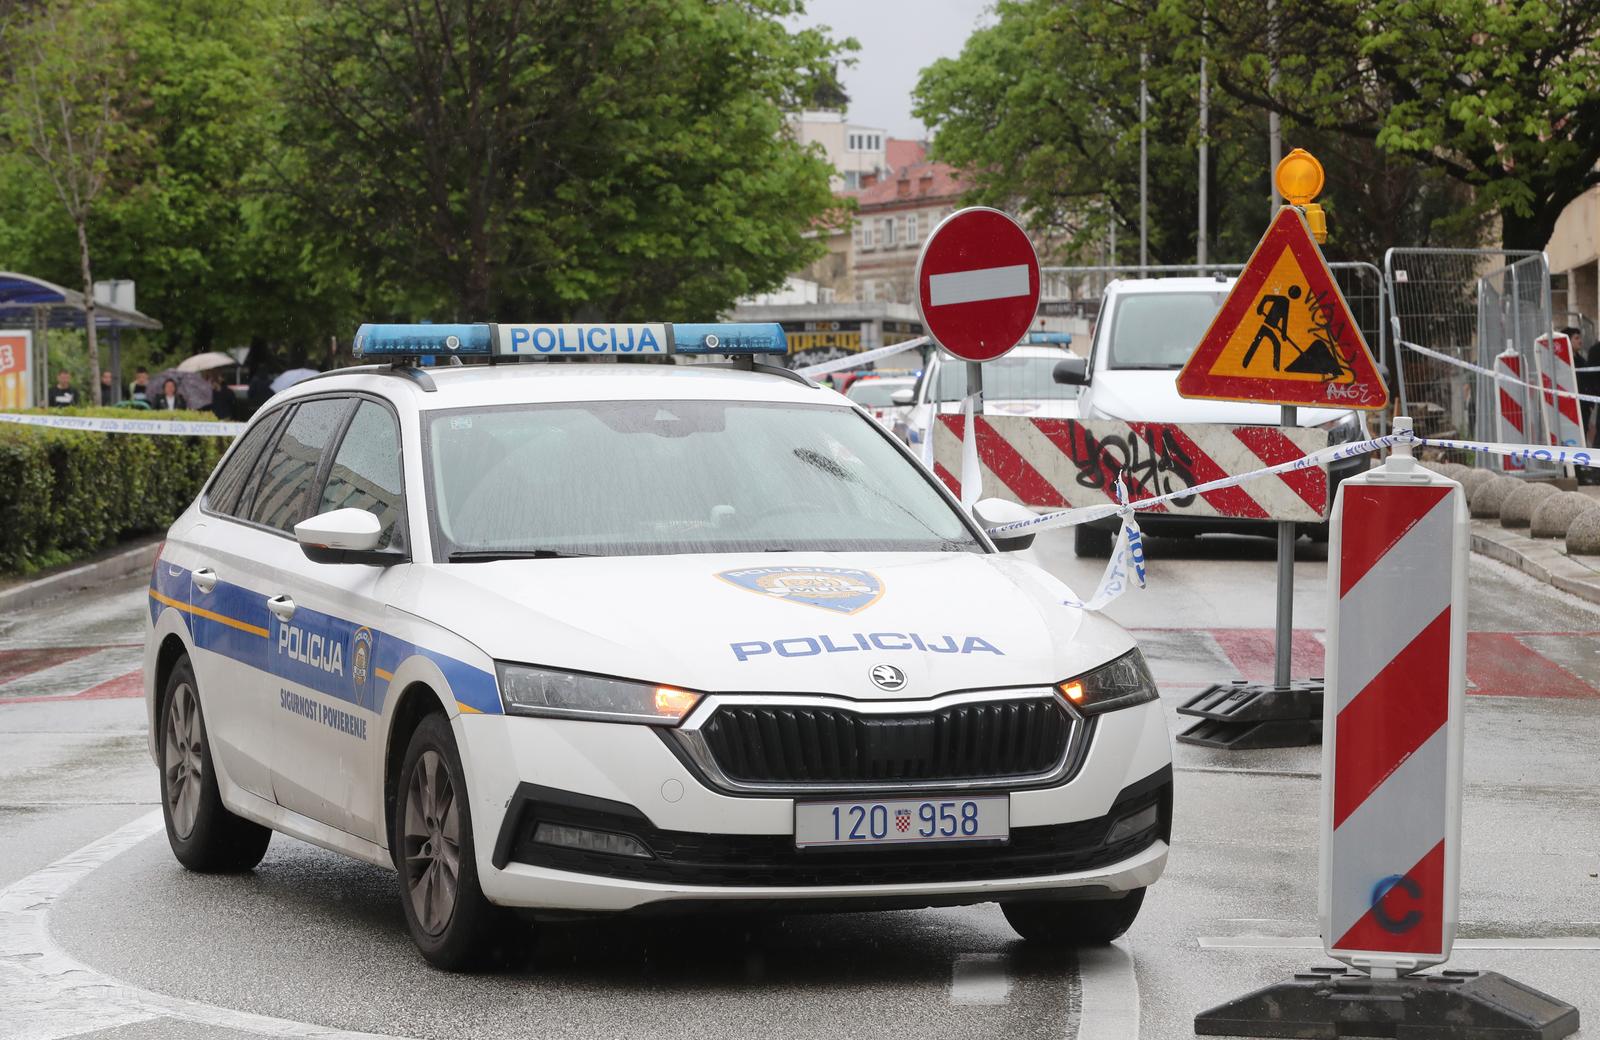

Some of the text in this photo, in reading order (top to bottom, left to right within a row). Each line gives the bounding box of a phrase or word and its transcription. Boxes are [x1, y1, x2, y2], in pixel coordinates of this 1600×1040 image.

[510, 327, 660, 353] POLICIJA
[278, 623, 344, 677] POLICIJA
[729, 632, 1007, 662] POLICIJA
[280, 688, 318, 721] SIGURNOST
[323, 705, 367, 741] POVJERENJE
[832, 801, 979, 841] 120 958
[1370, 874, 1423, 935] C
